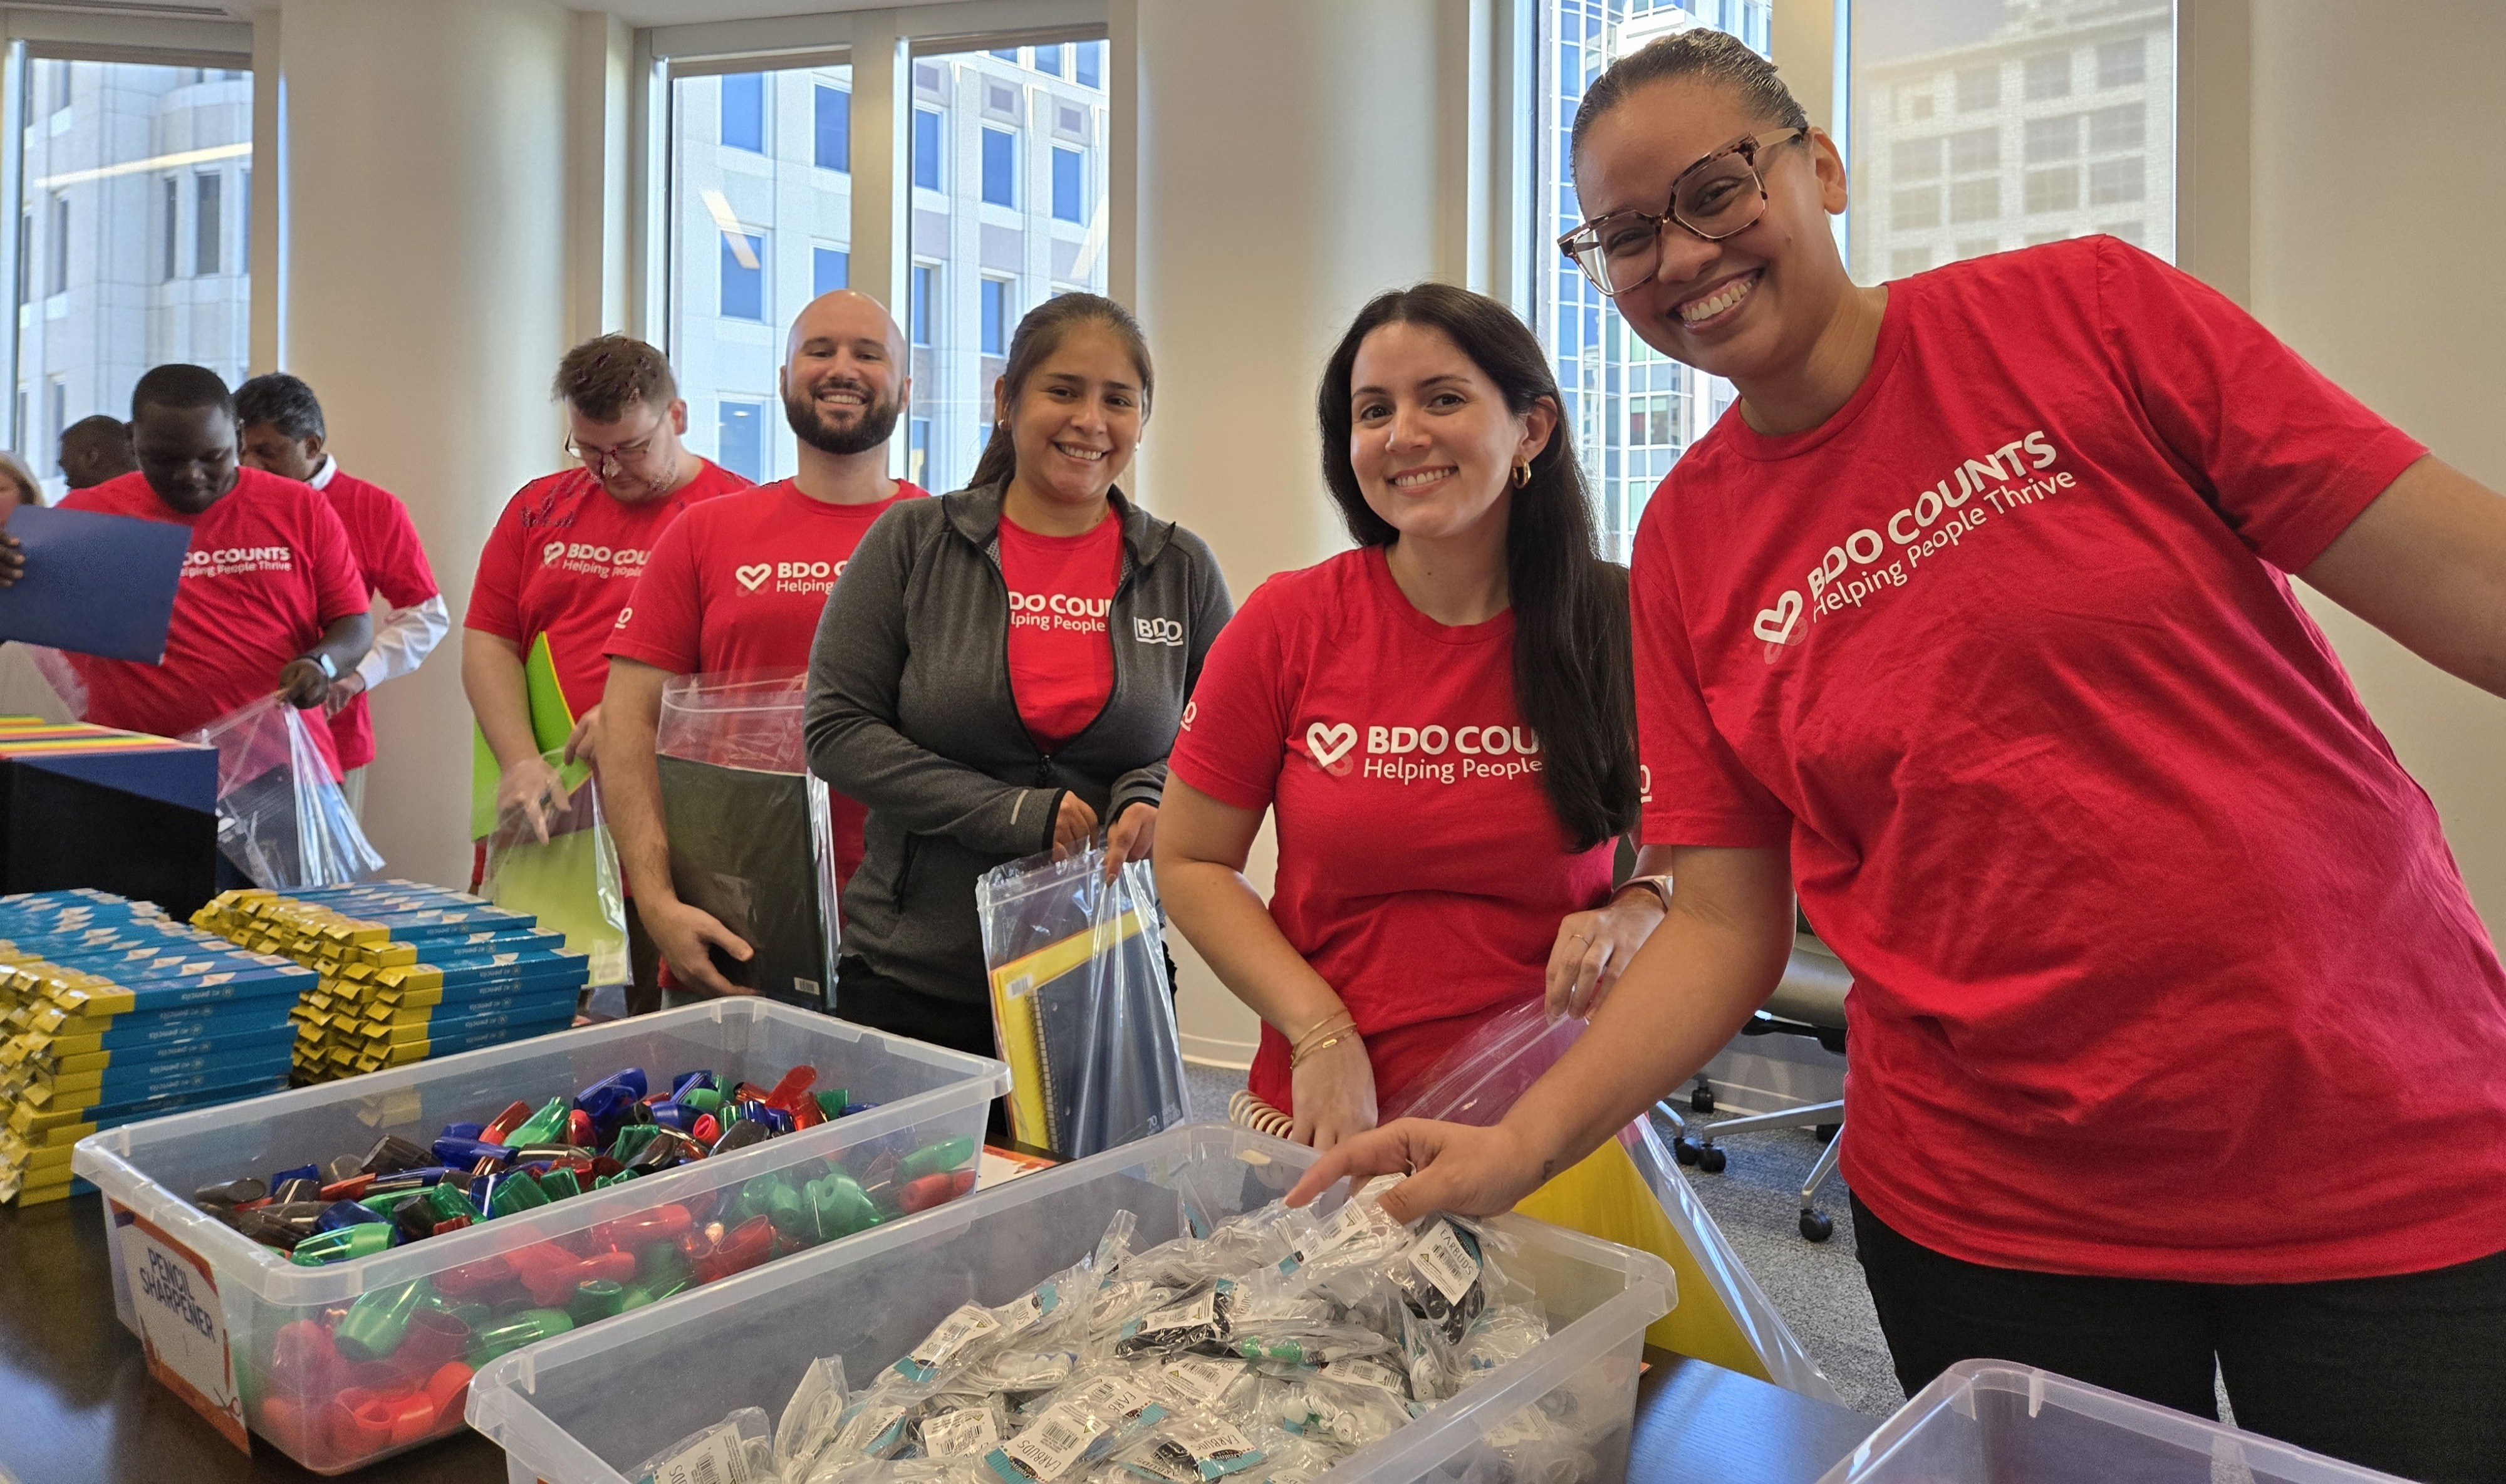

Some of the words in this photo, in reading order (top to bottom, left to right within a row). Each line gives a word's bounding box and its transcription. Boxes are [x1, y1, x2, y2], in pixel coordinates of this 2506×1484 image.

[1807, 529, 1883, 601] BDO
[1888, 430, 2057, 544] COUNTS
[182, 550, 211, 566] DO
[212, 547, 291, 564] COUNTS
[566, 542, 611, 563] BDO
[613, 549, 651, 565] COU
[1813, 560, 1908, 623] Helping
[1907, 506, 1987, 568] People
[1983, 471, 2077, 514] Thrive
[217, 561, 257, 574] People
[259, 560, 292, 571] Thrive
[562, 559, 610, 579] Helping
[777, 561, 830, 578] BDO
[776, 579, 834, 595] Helping
[1008, 591, 1046, 612] DO
[1049, 594, 1111, 618] COU
[1011, 611, 1051, 631] lping
[1054, 615, 1106, 635] People
[1136, 617, 1183, 642] BDO
[1367, 725, 1449, 755] BDO
[1455, 725, 1539, 755] COU
[1363, 758, 1455, 785] Helping
[1463, 757, 1543, 780] People
[1440, 1228, 1474, 1275] EARBUDS
[147, 1247, 195, 1301] PENCIL
[139, 1267, 217, 1344] SHARPENER
[1108, 1391, 1136, 1412] EARB
[1190, 1435, 1240, 1451] EARBUDS
[1017, 1440, 1062, 1473] EARBUDS
[1212, 1450, 1242, 1461] Creative
[1009, 1460, 1032, 1480] Creative
